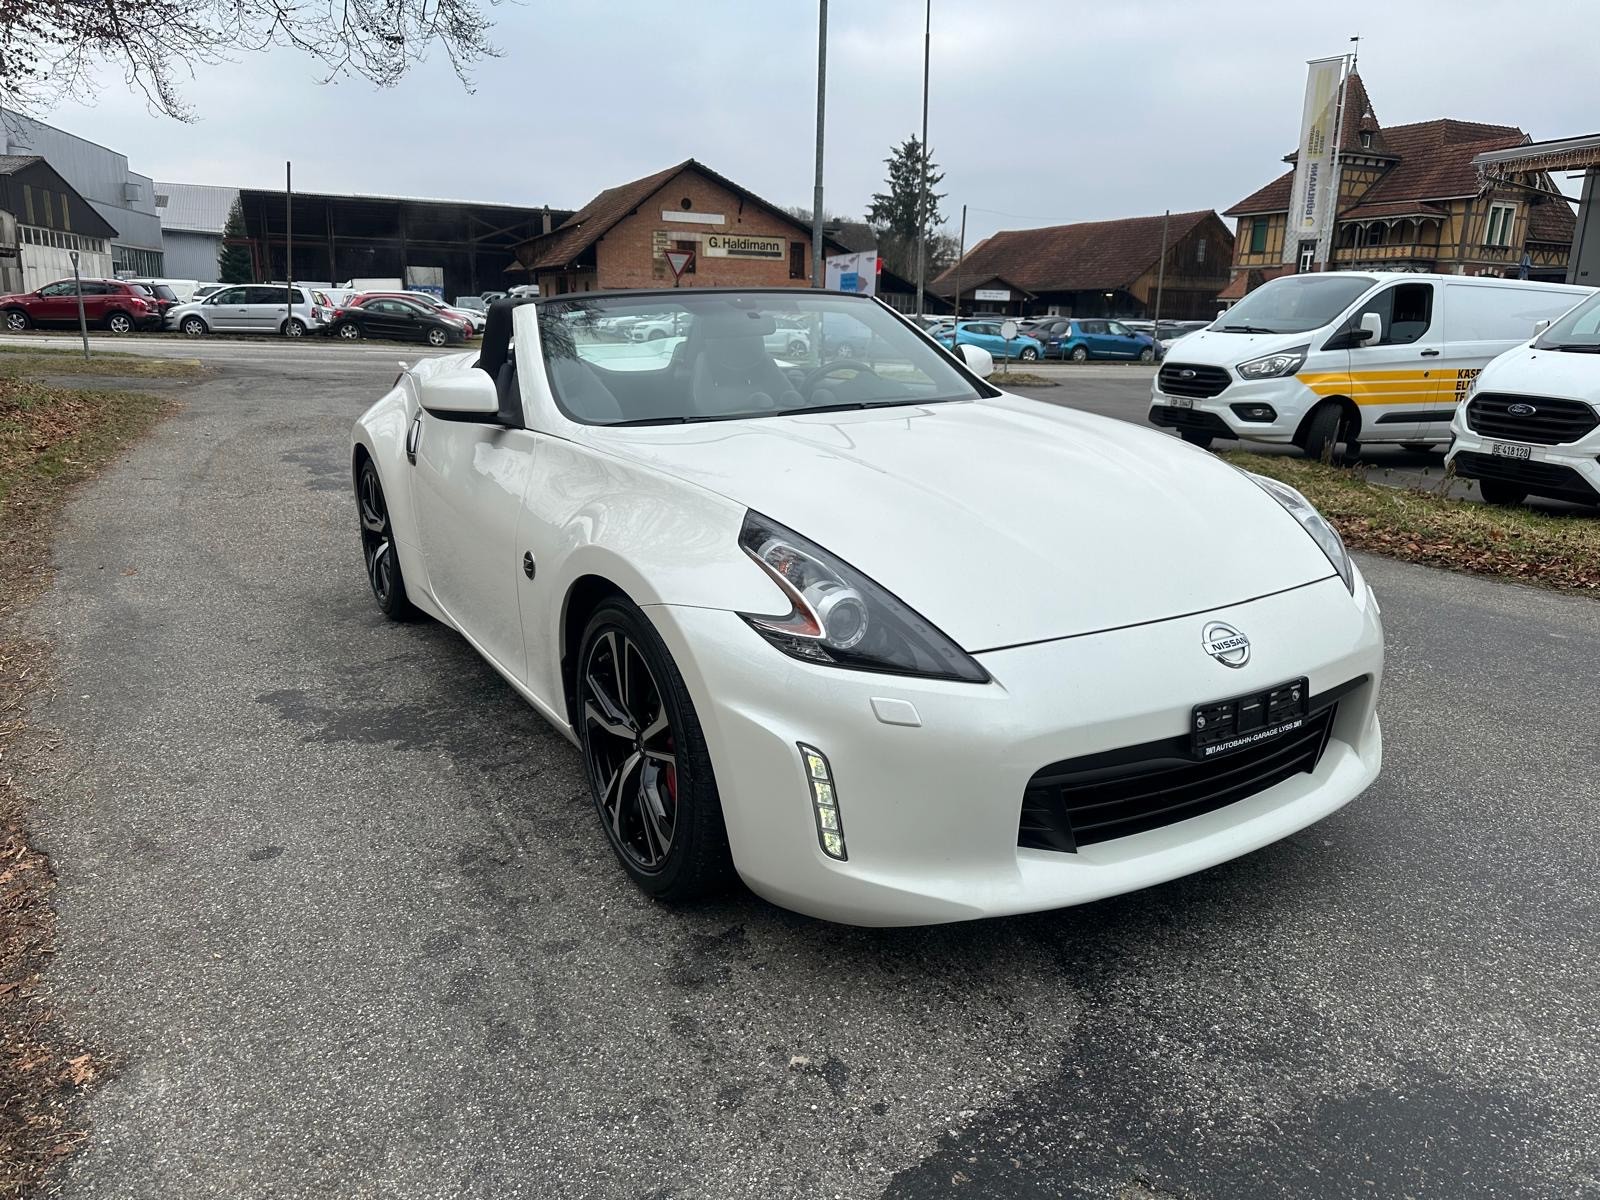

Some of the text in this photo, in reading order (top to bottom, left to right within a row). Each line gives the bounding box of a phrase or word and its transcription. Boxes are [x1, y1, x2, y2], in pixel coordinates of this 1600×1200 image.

[708, 236, 779, 251] G. Haldimann
[1493, 444, 1502, 454] BE
[1211, 637, 1248, 651] NISSAN
[1215, 727, 1278, 753] AUTOBAHN-GARAGE
[1278, 722, 1293, 733] LYSS
